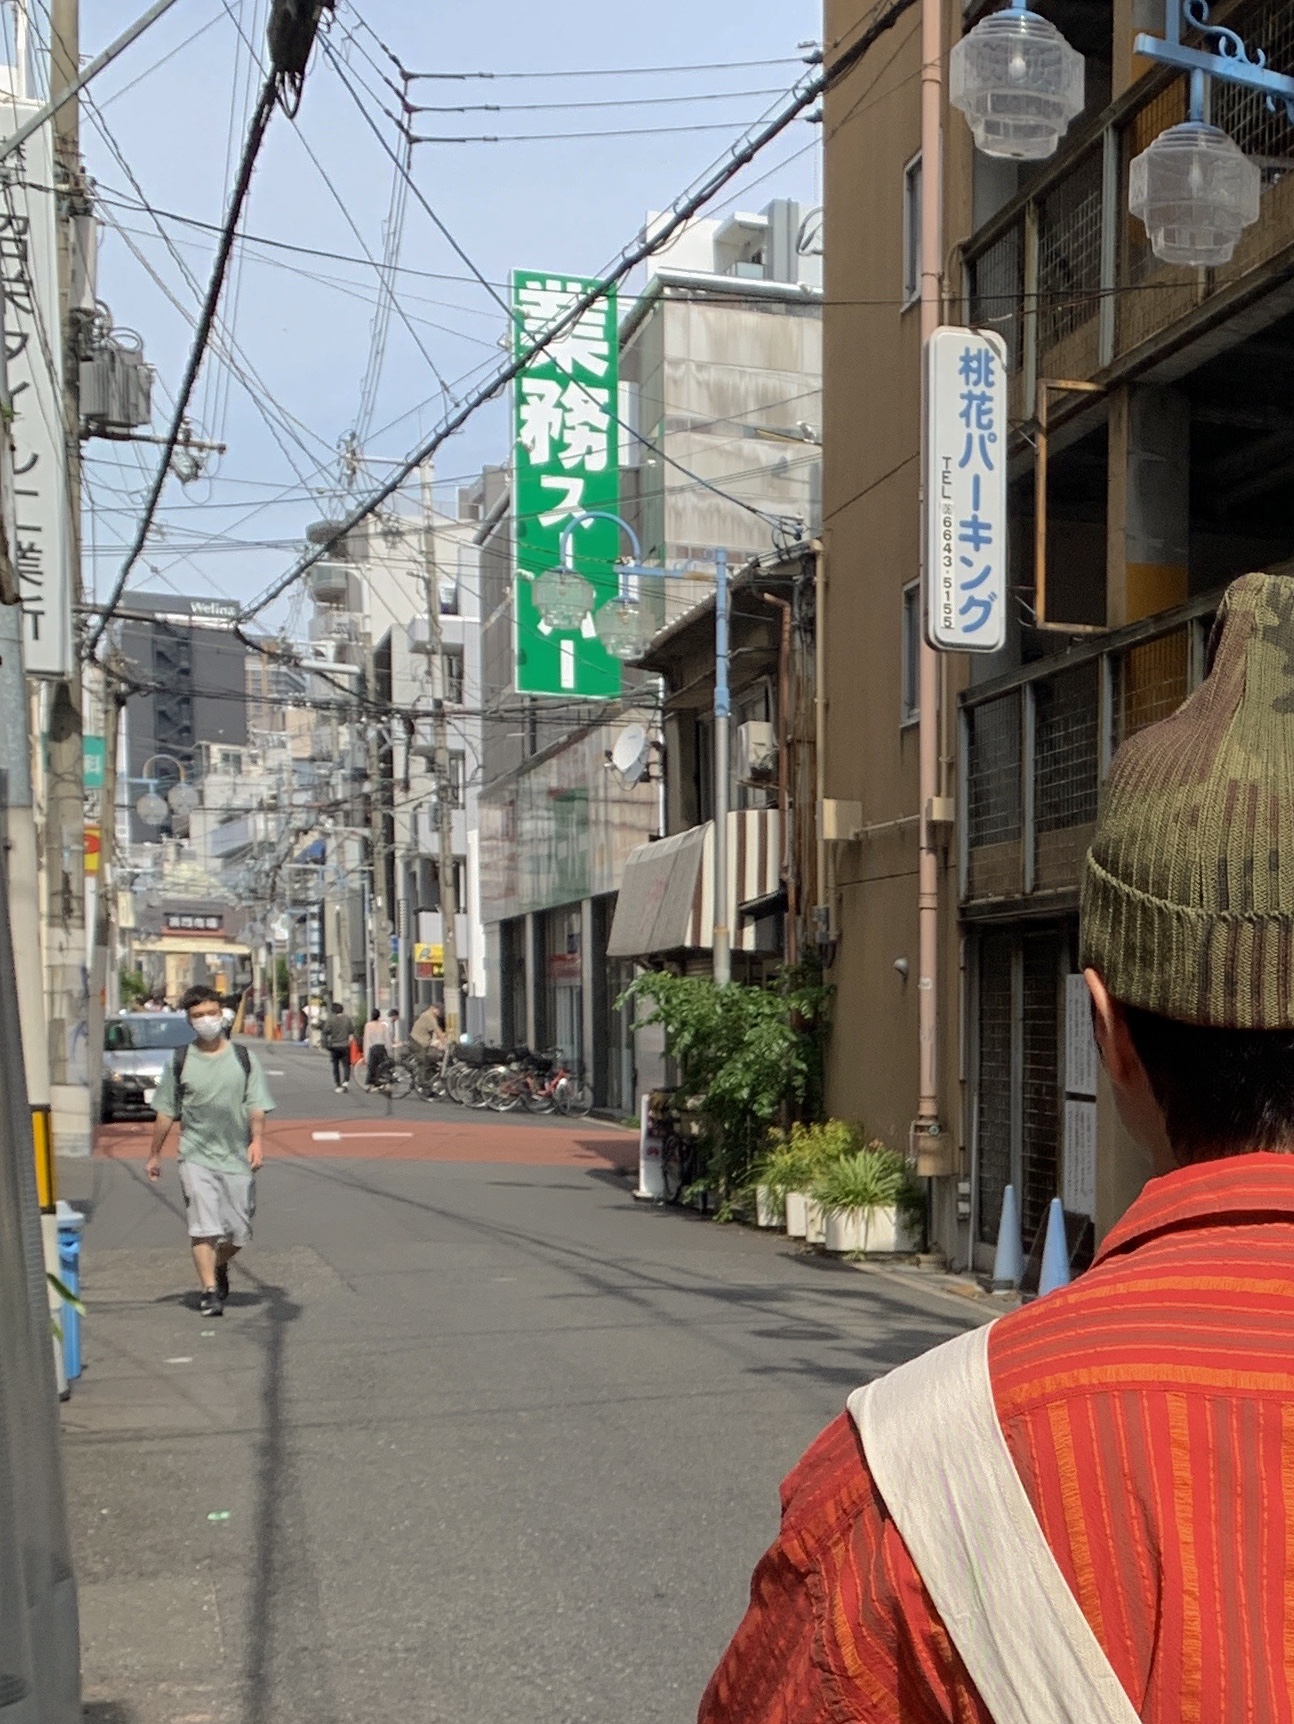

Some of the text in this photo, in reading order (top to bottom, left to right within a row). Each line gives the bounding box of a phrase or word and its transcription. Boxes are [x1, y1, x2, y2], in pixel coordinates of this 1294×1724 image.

[518, 280, 609, 689] 業務スーー
[941, 456, 952, 499] TEL
[958, 346, 998, 634] 桃花パーキング
